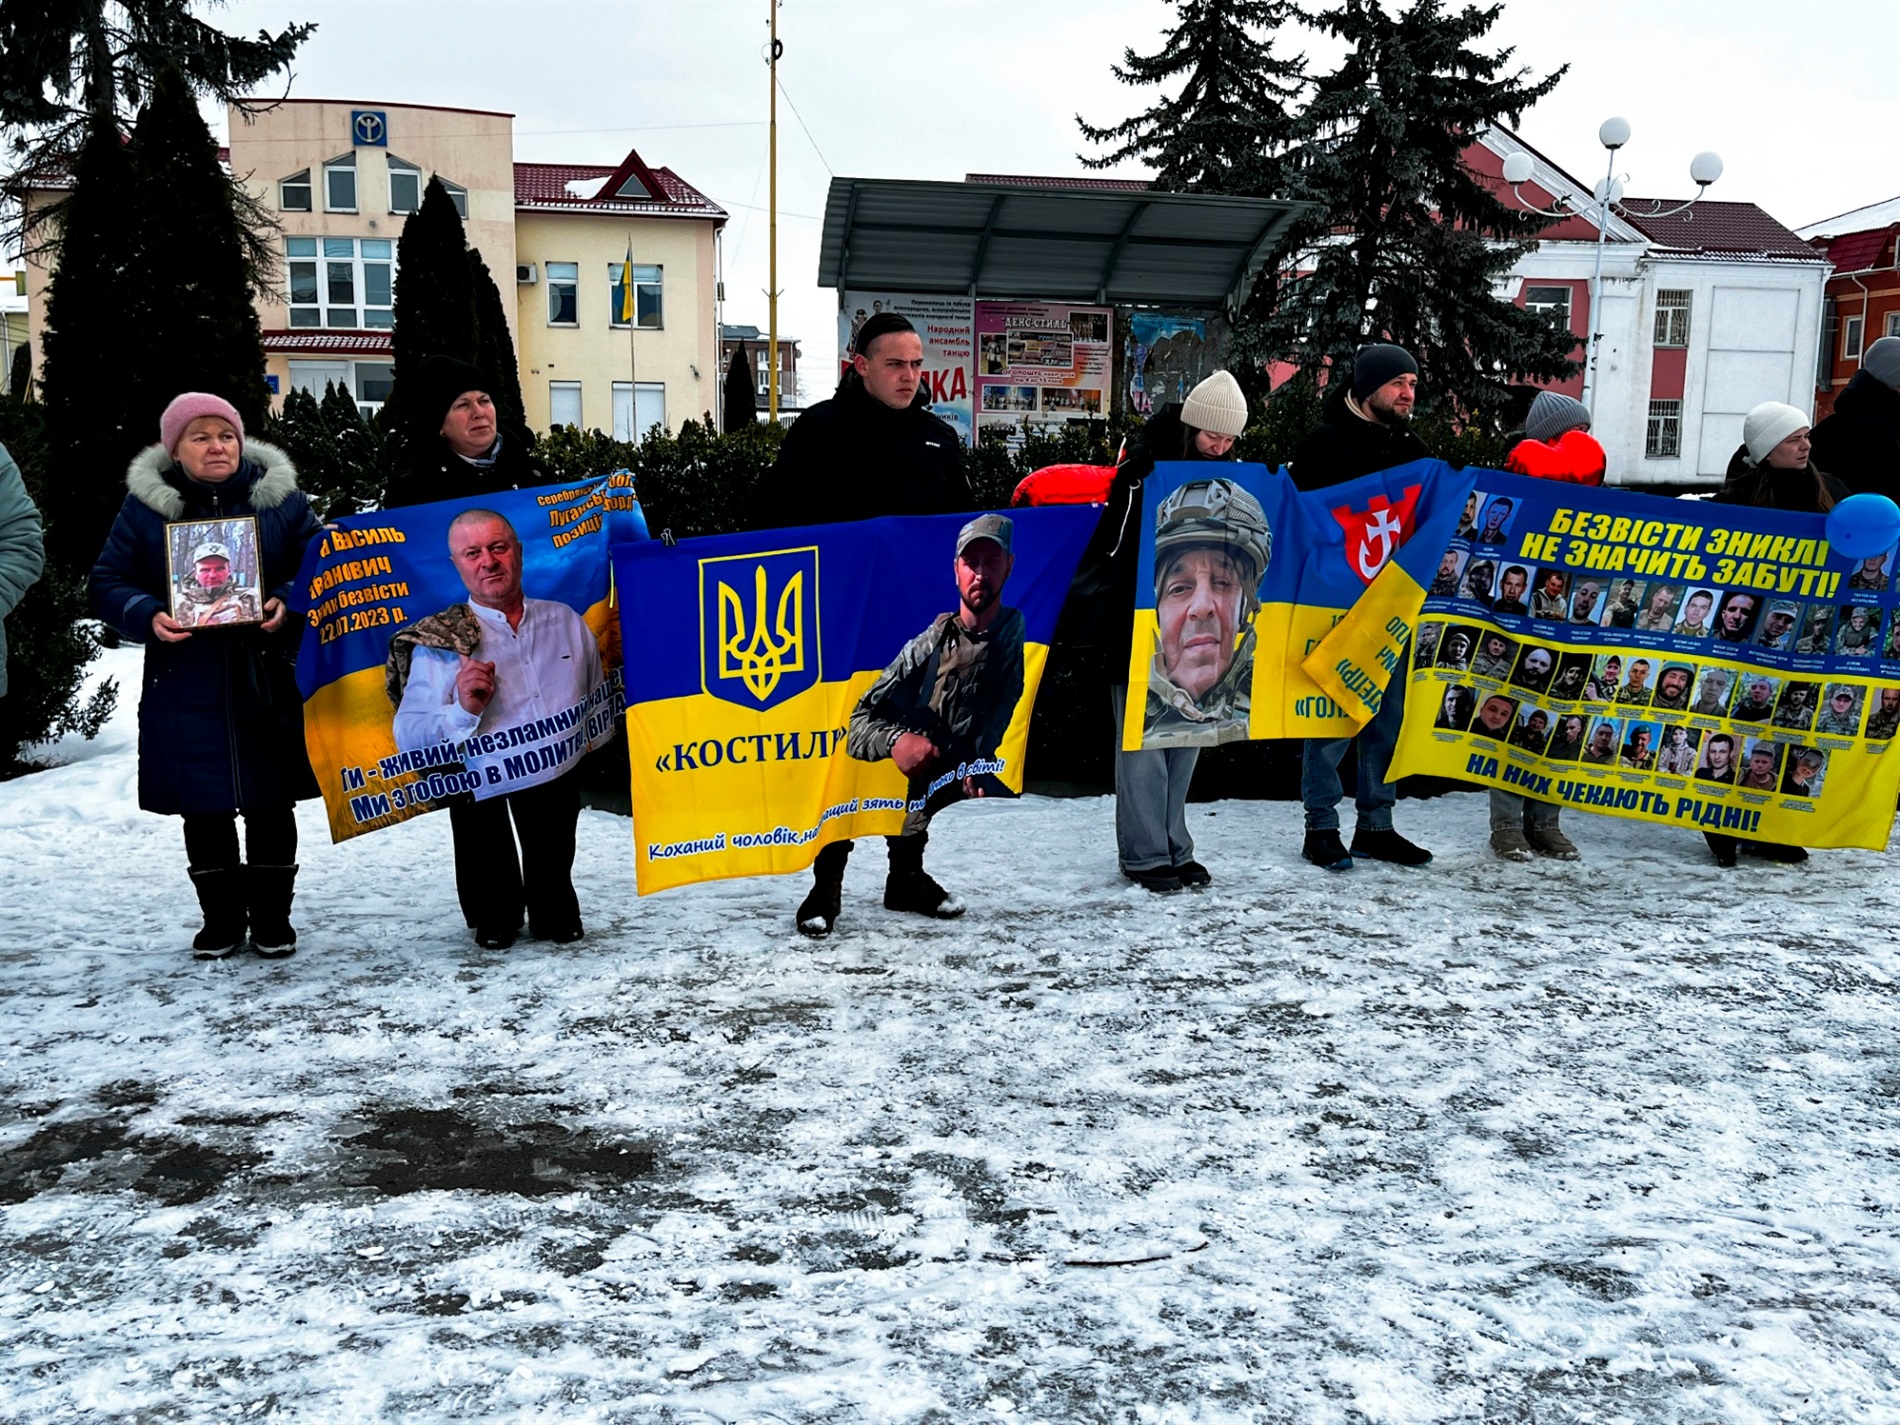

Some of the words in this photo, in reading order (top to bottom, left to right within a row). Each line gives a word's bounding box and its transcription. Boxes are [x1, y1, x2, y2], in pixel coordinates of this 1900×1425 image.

[927, 325, 970, 334] Народний
[929, 337, 970, 346] ансамбль
[943, 350, 970, 358] танцю
[552, 513, 602, 548] позиці
[1549, 507, 1704, 551] БЕЗВІСТИ
[1705, 526, 1829, 567] ЗНИКЛІ
[1519, 532, 1562, 562] НЕ
[1564, 540, 1706, 581] ЗНАЧИТЬ
[1710, 556, 1842, 599] ЗАБУТІ!
[338, 582, 410, 609] безвісти
[391, 607, 408, 624] р.
[379, 739, 465, 780] живий,
[350, 791, 390, 822] Ми
[391, 787, 406, 809] з
[407, 769, 481, 806] тобою
[487, 765, 501, 785] в
[649, 833, 725, 861] Коханий
[862, 798, 905, 811] зять
[966, 759, 1006, 776] світі!
[1466, 753, 1498, 779] НА
[1502, 763, 1552, 796] НИХ
[1556, 779, 1670, 816] ЧЕКАЮТЬ
[1674, 798, 1761, 833] РІДНІ!
